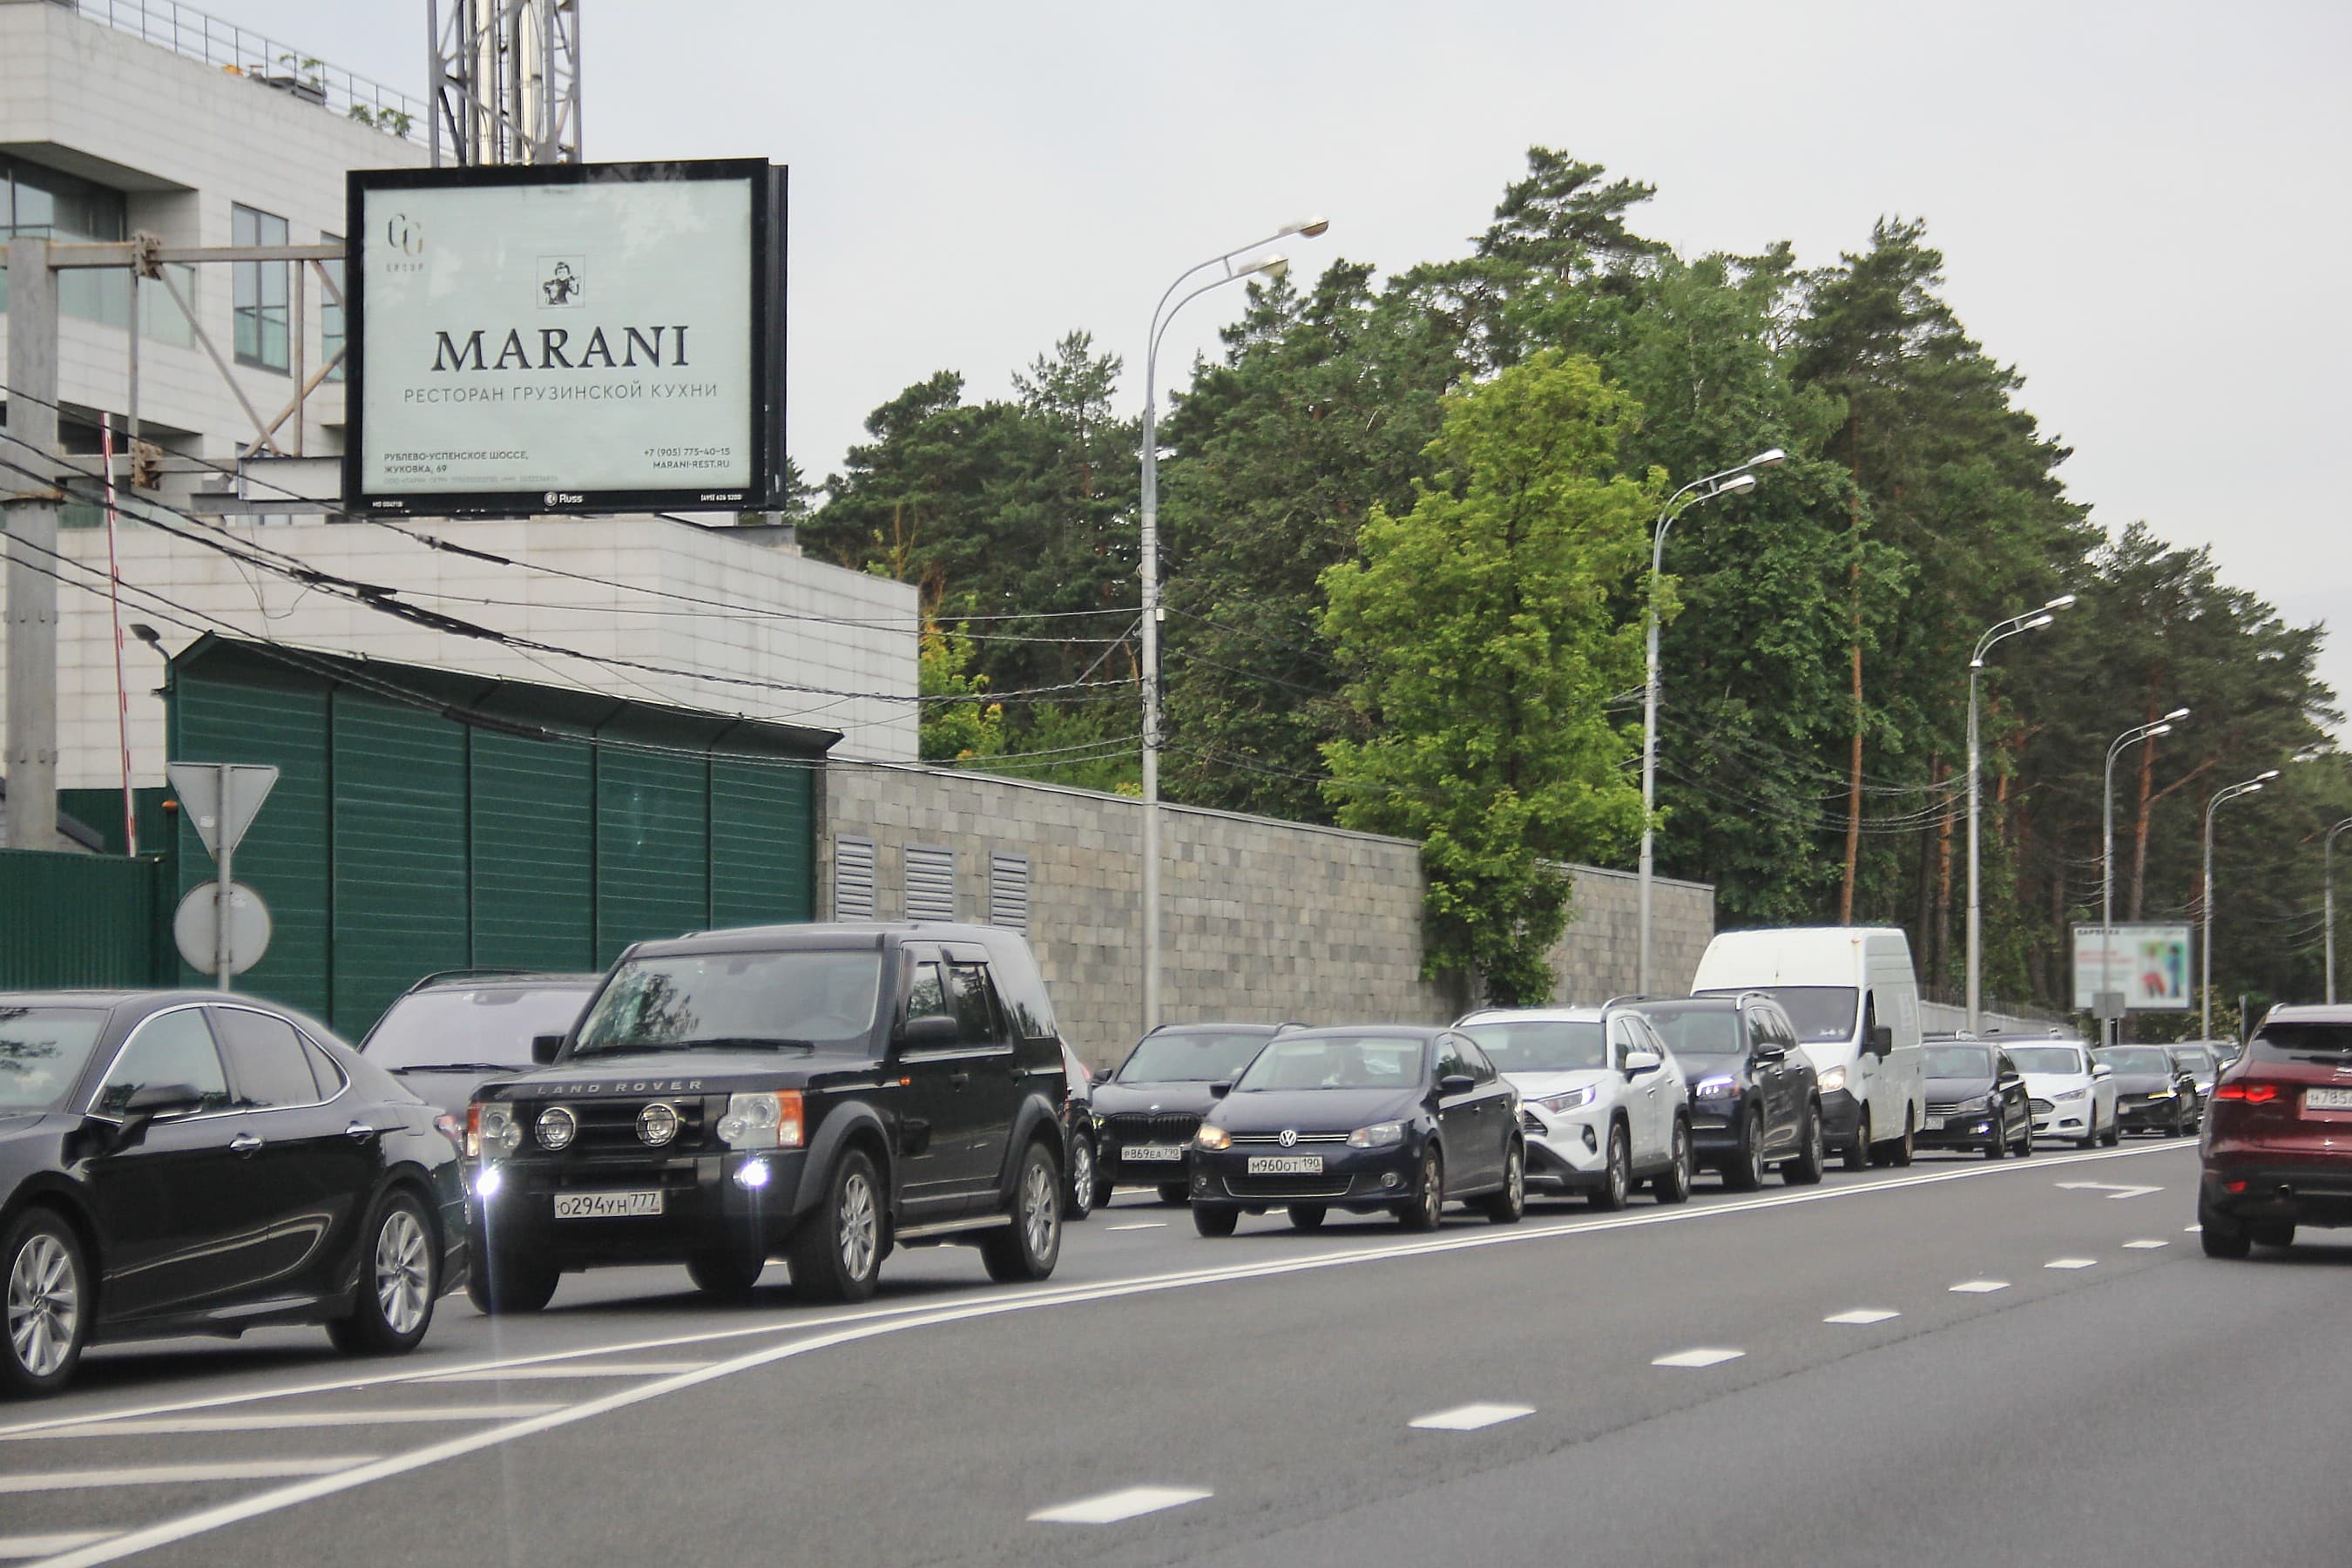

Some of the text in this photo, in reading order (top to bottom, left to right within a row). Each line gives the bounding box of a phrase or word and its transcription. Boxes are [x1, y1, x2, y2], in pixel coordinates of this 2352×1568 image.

[430, 325, 689, 372] MARANI
[404, 380, 718, 403] РЕСТОРАН ГРУЗИНСКОЙ КУХНИ
[384, 450, 530, 462] РУБЛЕВО-УСПЕНСКОЕ ШОССЕ,
[384, 464, 448, 475] ЖУКОВКА, 69
[652, 459, 731, 470] MARANI-REST.RU
[558, 493, 584, 504] Russ
[537, 1081, 702, 1095] LAND ROVER
[1252, 1158, 1319, 1172] М960ОТ 190
[559, 1193, 656, 1215] О294УН 777
